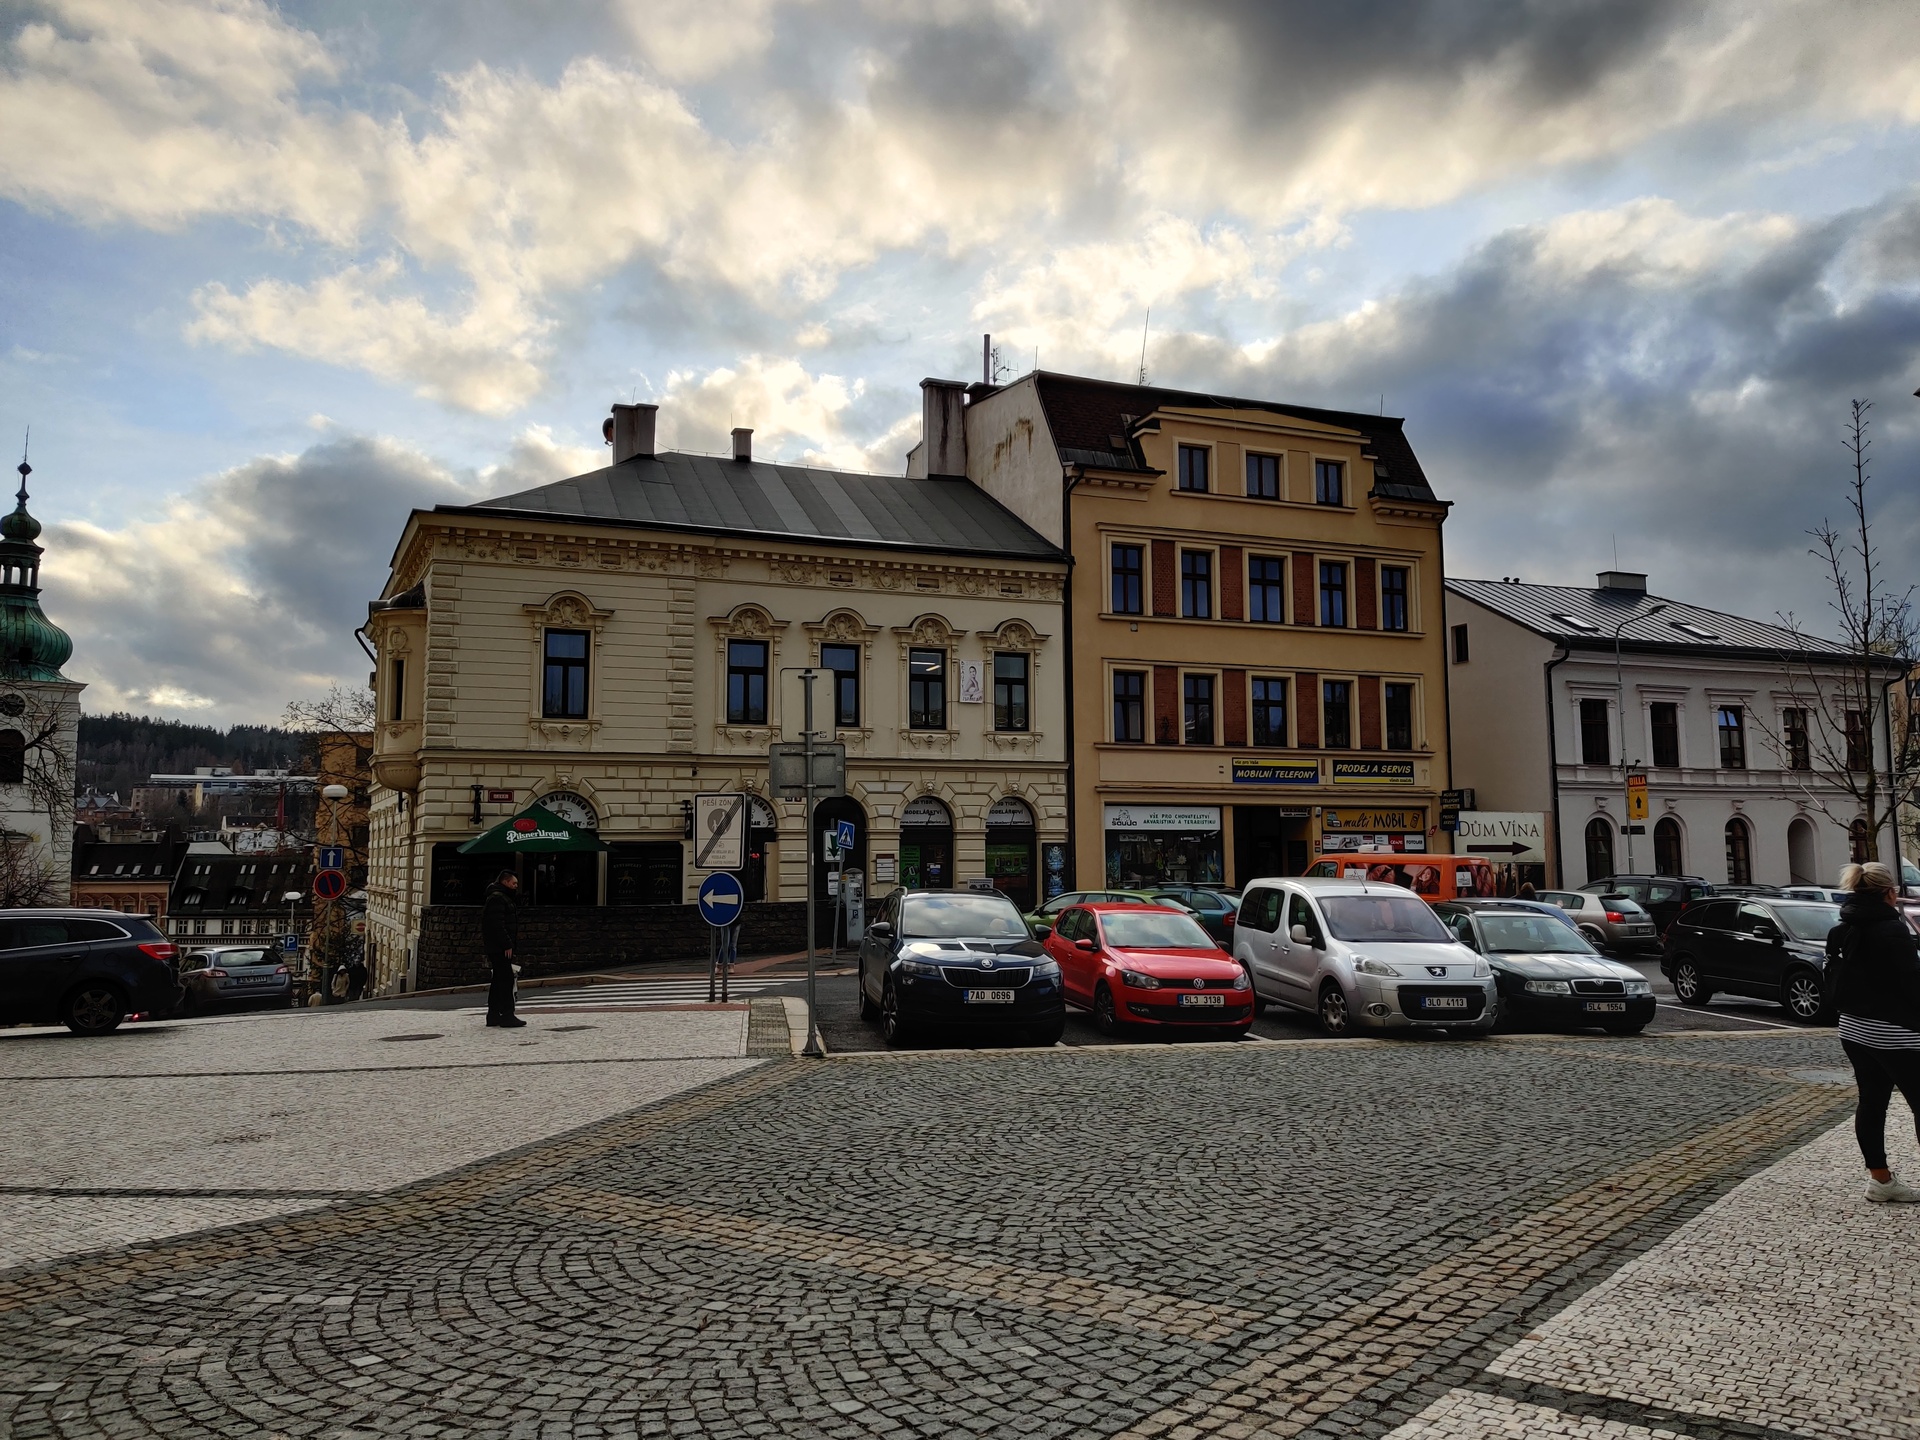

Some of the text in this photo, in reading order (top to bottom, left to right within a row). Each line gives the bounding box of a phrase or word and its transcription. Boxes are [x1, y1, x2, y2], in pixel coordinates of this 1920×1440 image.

[1236, 768, 1315, 779] MOBILNÍ TELEFONY
[1336, 764, 1411, 774] PRODEJ A SERVIS
[1629, 776, 1646, 786] BILLA
[702, 797, 717, 807] PĚŠÍ
[540, 798, 548, 806] U
[585, 810, 595, 826] LVA
[766, 812, 774, 827] LVA
[1343, 813, 1371, 828] multi
[1458, 820, 1540, 837] DŮM VÍNA
[506, 828, 569, 844] Pilsner Urquell
[286, 936, 296, 947] P
[970, 991, 1011, 999] 7AD 0696
[1185, 996, 1221, 1004] 5L3 3138
